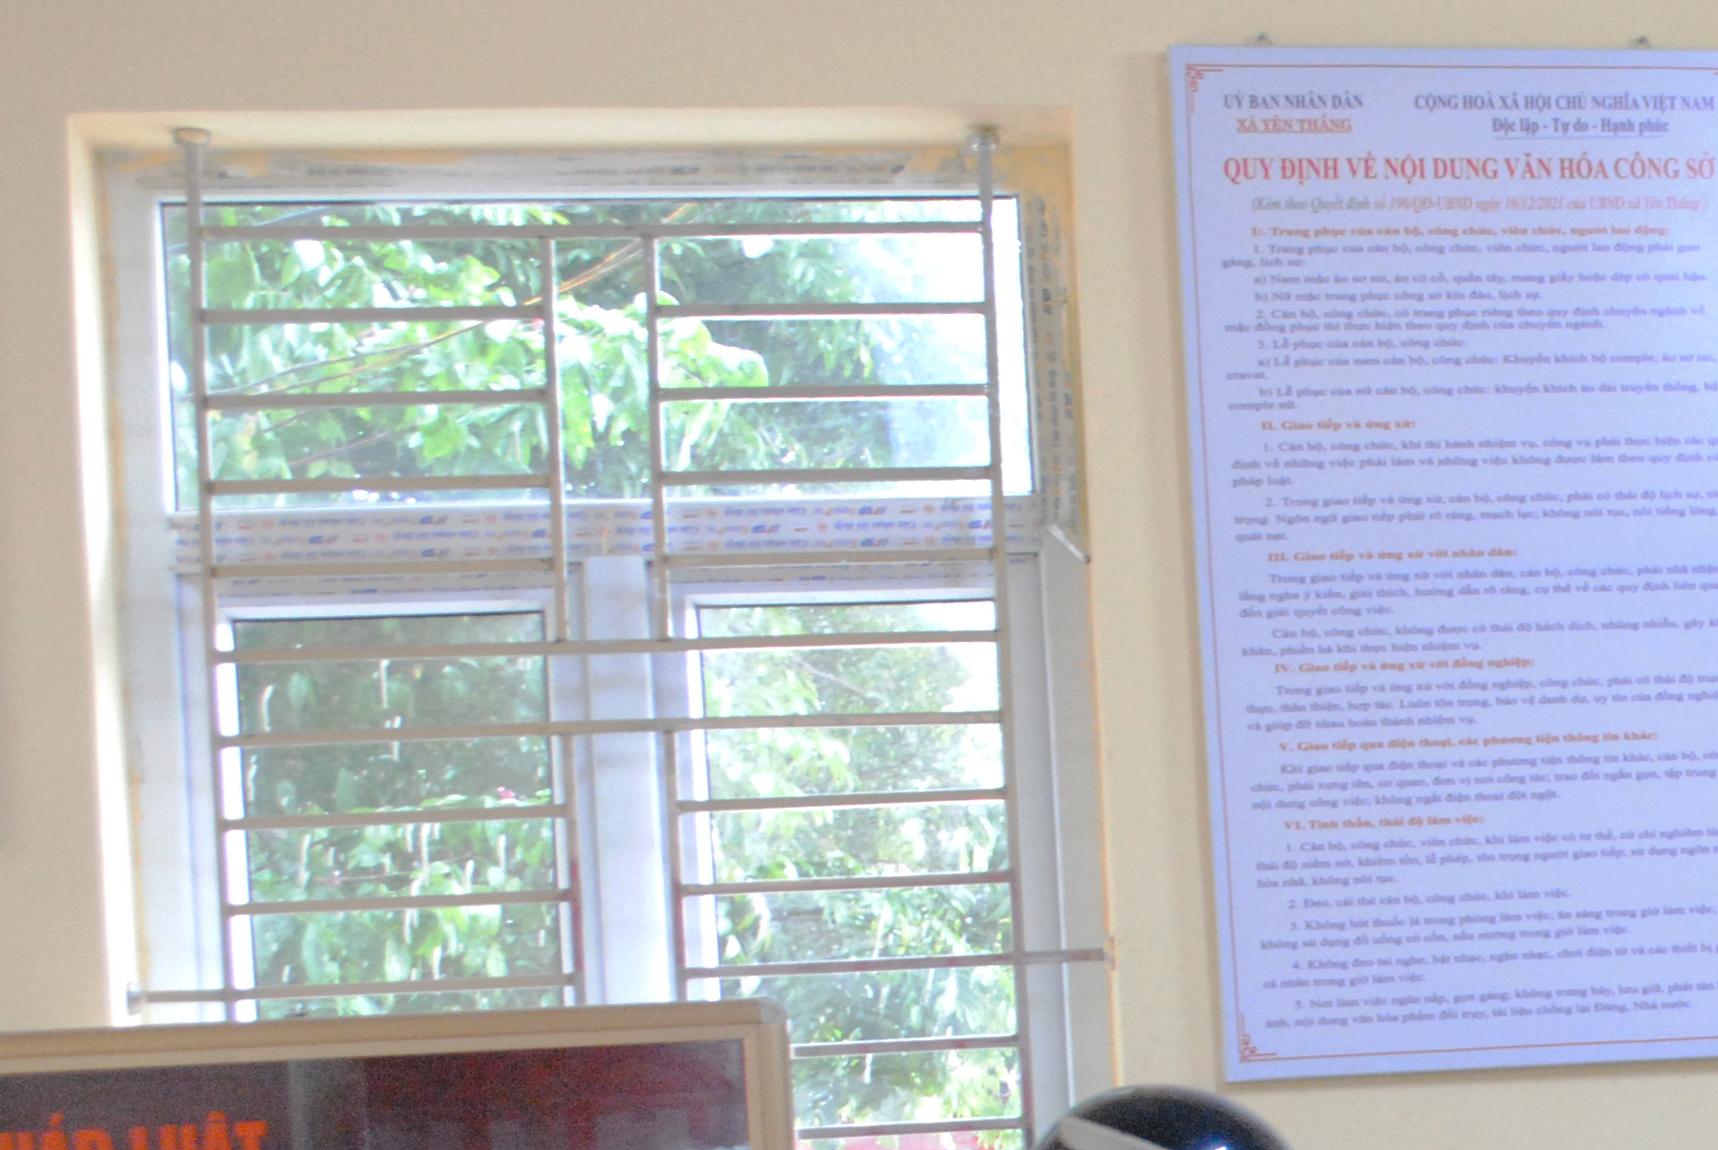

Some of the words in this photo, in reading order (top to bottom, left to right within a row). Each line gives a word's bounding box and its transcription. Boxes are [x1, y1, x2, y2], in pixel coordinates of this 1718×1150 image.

[1222, 157, 1271, 184] QUY
[1280, 157, 1339, 184] ĐỊNH
[1347, 152, 1376, 179] VỀ
[1384, 155, 1426, 184] NỘI
[1432, 157, 1498, 179] DUNG
[1504, 153, 1552, 179] VĂN
[1558, 151, 1607, 179] HÓA
[1612, 151, 1679, 179] CÔNG
[1685, 152, 1715, 178] SỞ
